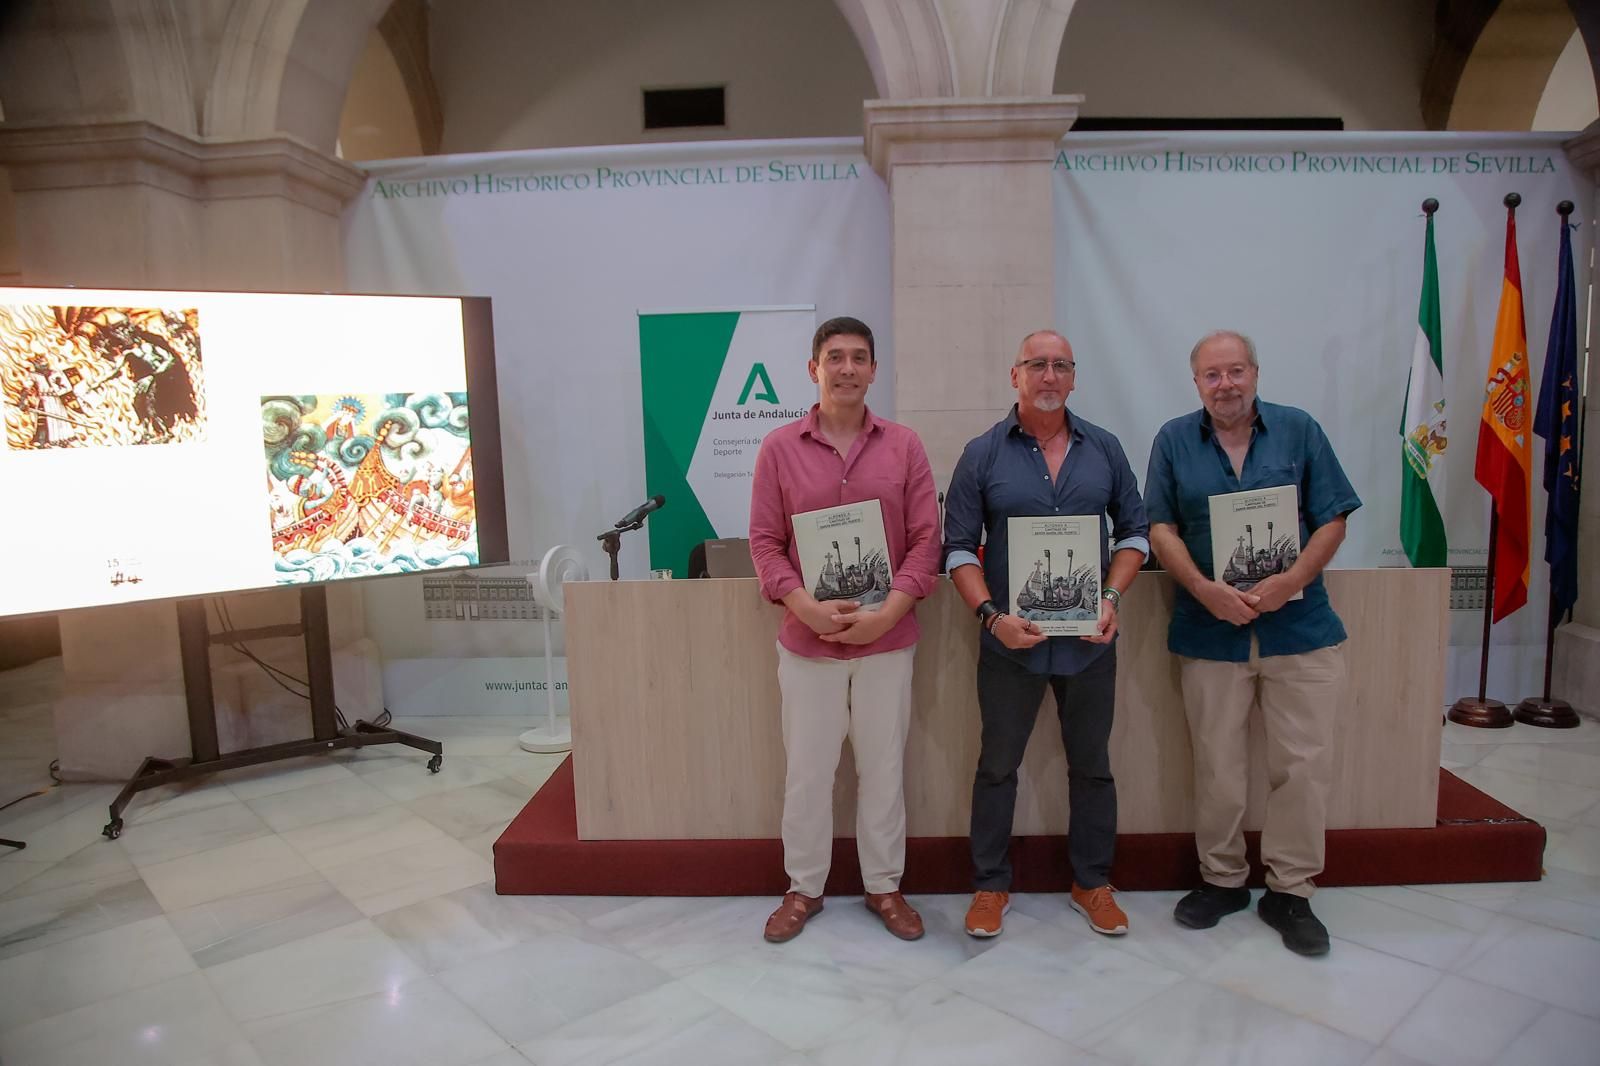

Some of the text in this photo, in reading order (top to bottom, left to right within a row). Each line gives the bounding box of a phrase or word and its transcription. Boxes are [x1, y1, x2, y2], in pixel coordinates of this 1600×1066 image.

[1053, 150, 1556, 174] ARCHIVO HISTÓRICO PROVINCIAL DE SEVILLA
[370, 159, 860, 199] ARCHIVO HISTÓRICO PROVINCIAL DE SEVILLA
[712, 408, 808, 421] Junta de Andalucía
[713, 438, 751, 447] Consejería
[713, 448, 742, 457] Deporte
[714, 471, 746, 479] Delegación
[107, 558, 119, 568] 15
